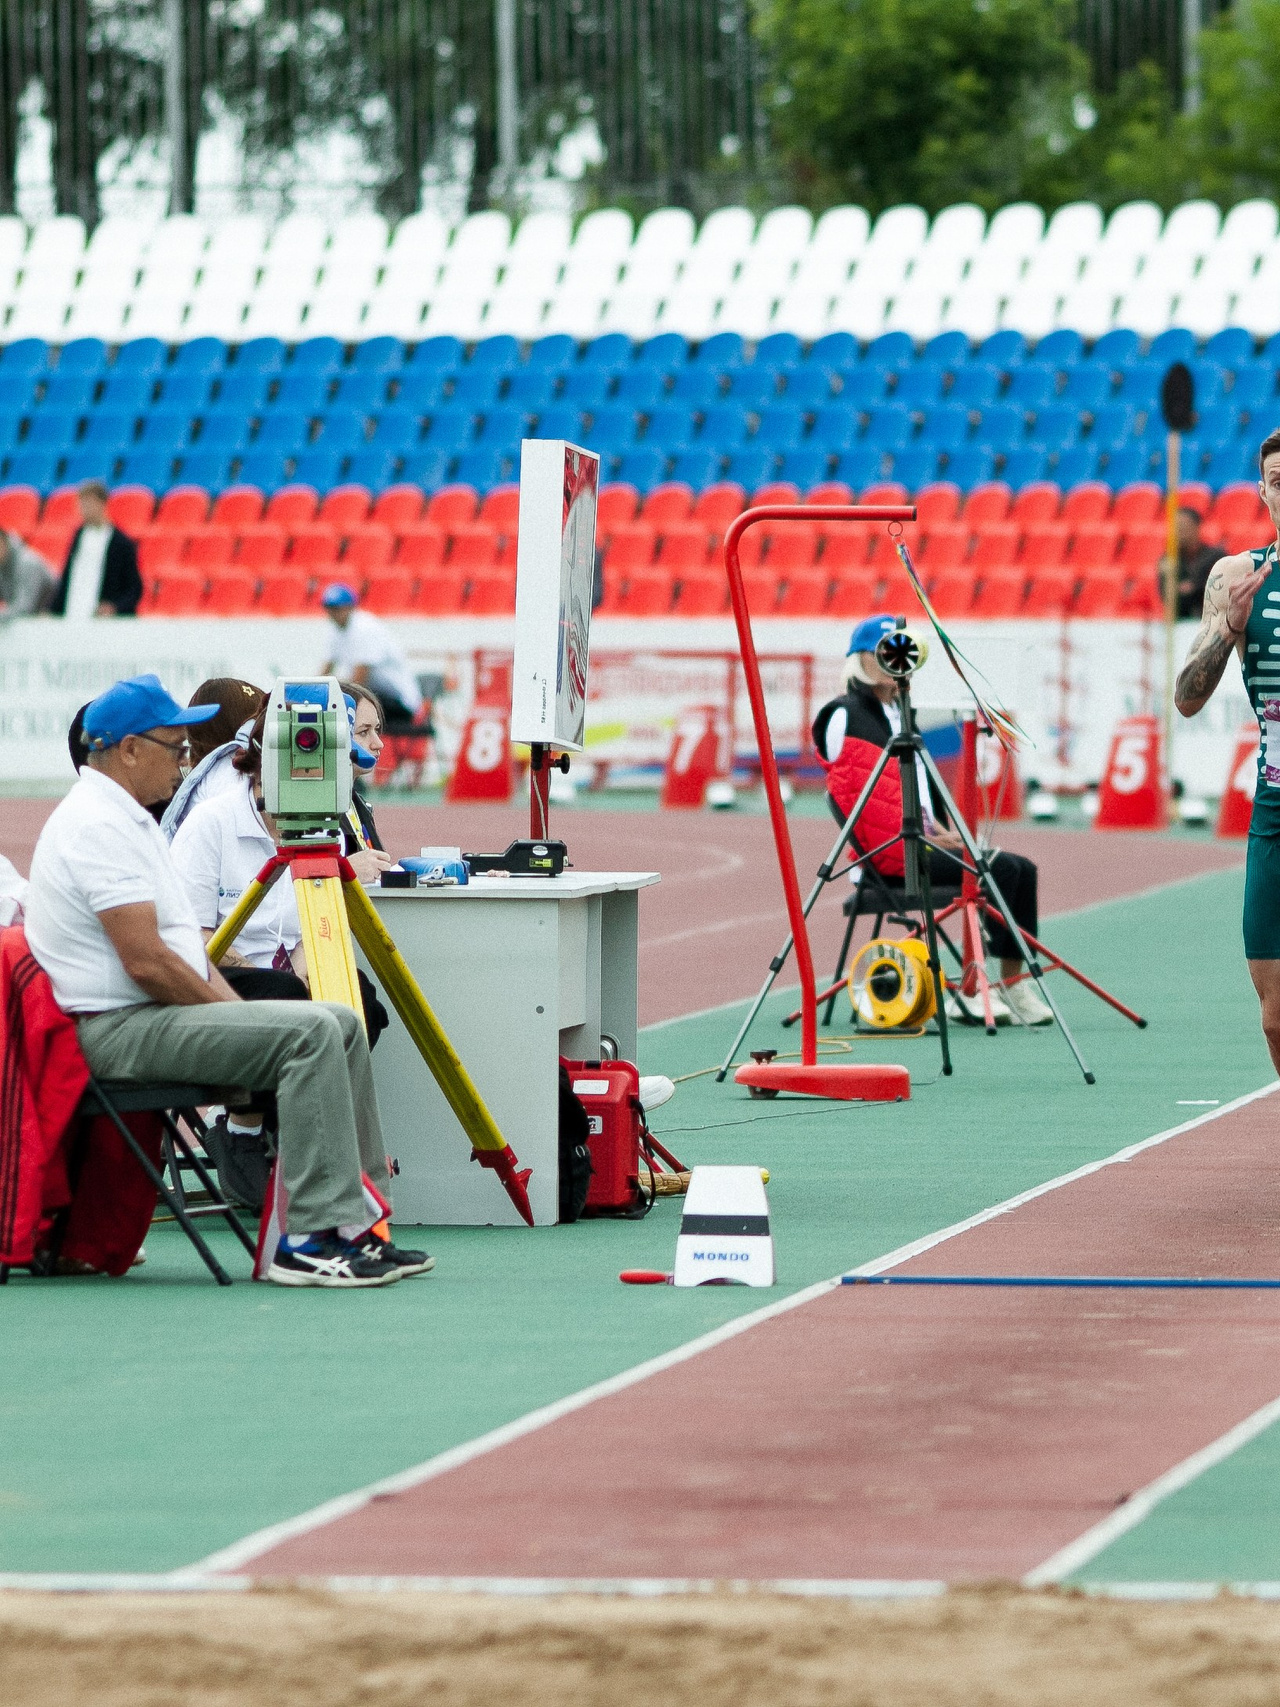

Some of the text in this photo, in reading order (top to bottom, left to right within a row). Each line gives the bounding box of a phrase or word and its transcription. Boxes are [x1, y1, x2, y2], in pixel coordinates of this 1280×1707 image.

[466, 720, 503, 772] 8
[673, 722, 706, 774] 7
[1109, 737, 1148, 794] 5
[692, 1252, 750, 1261] MONDO
